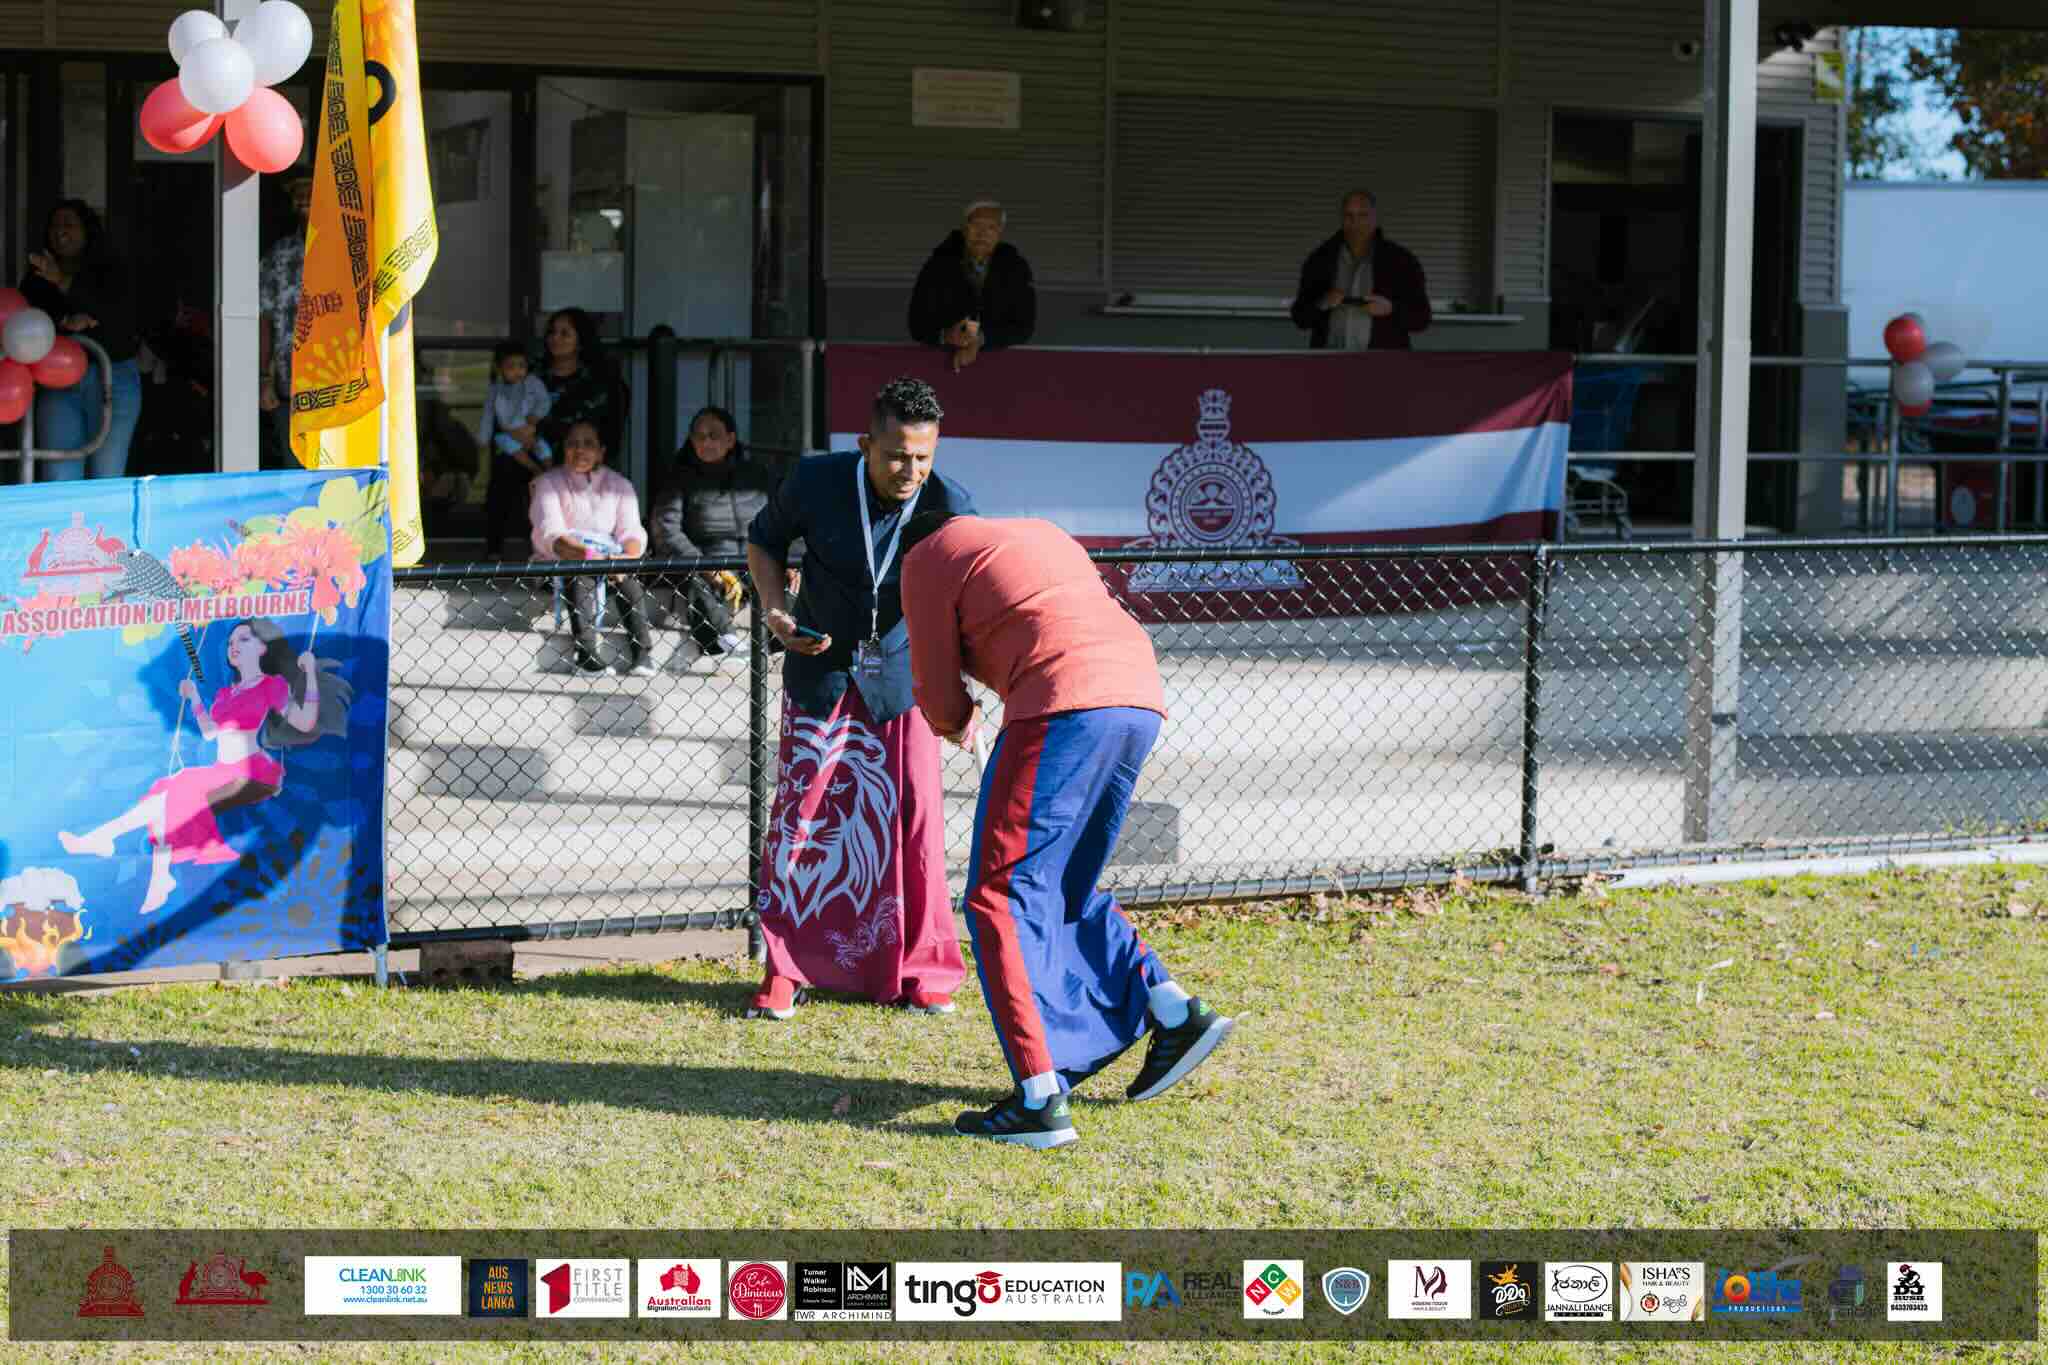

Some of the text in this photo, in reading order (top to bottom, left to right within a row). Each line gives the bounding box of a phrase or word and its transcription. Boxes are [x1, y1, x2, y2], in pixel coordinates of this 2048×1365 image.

[1, 590, 311, 636] ASSOICATION OF MELBOURNE
